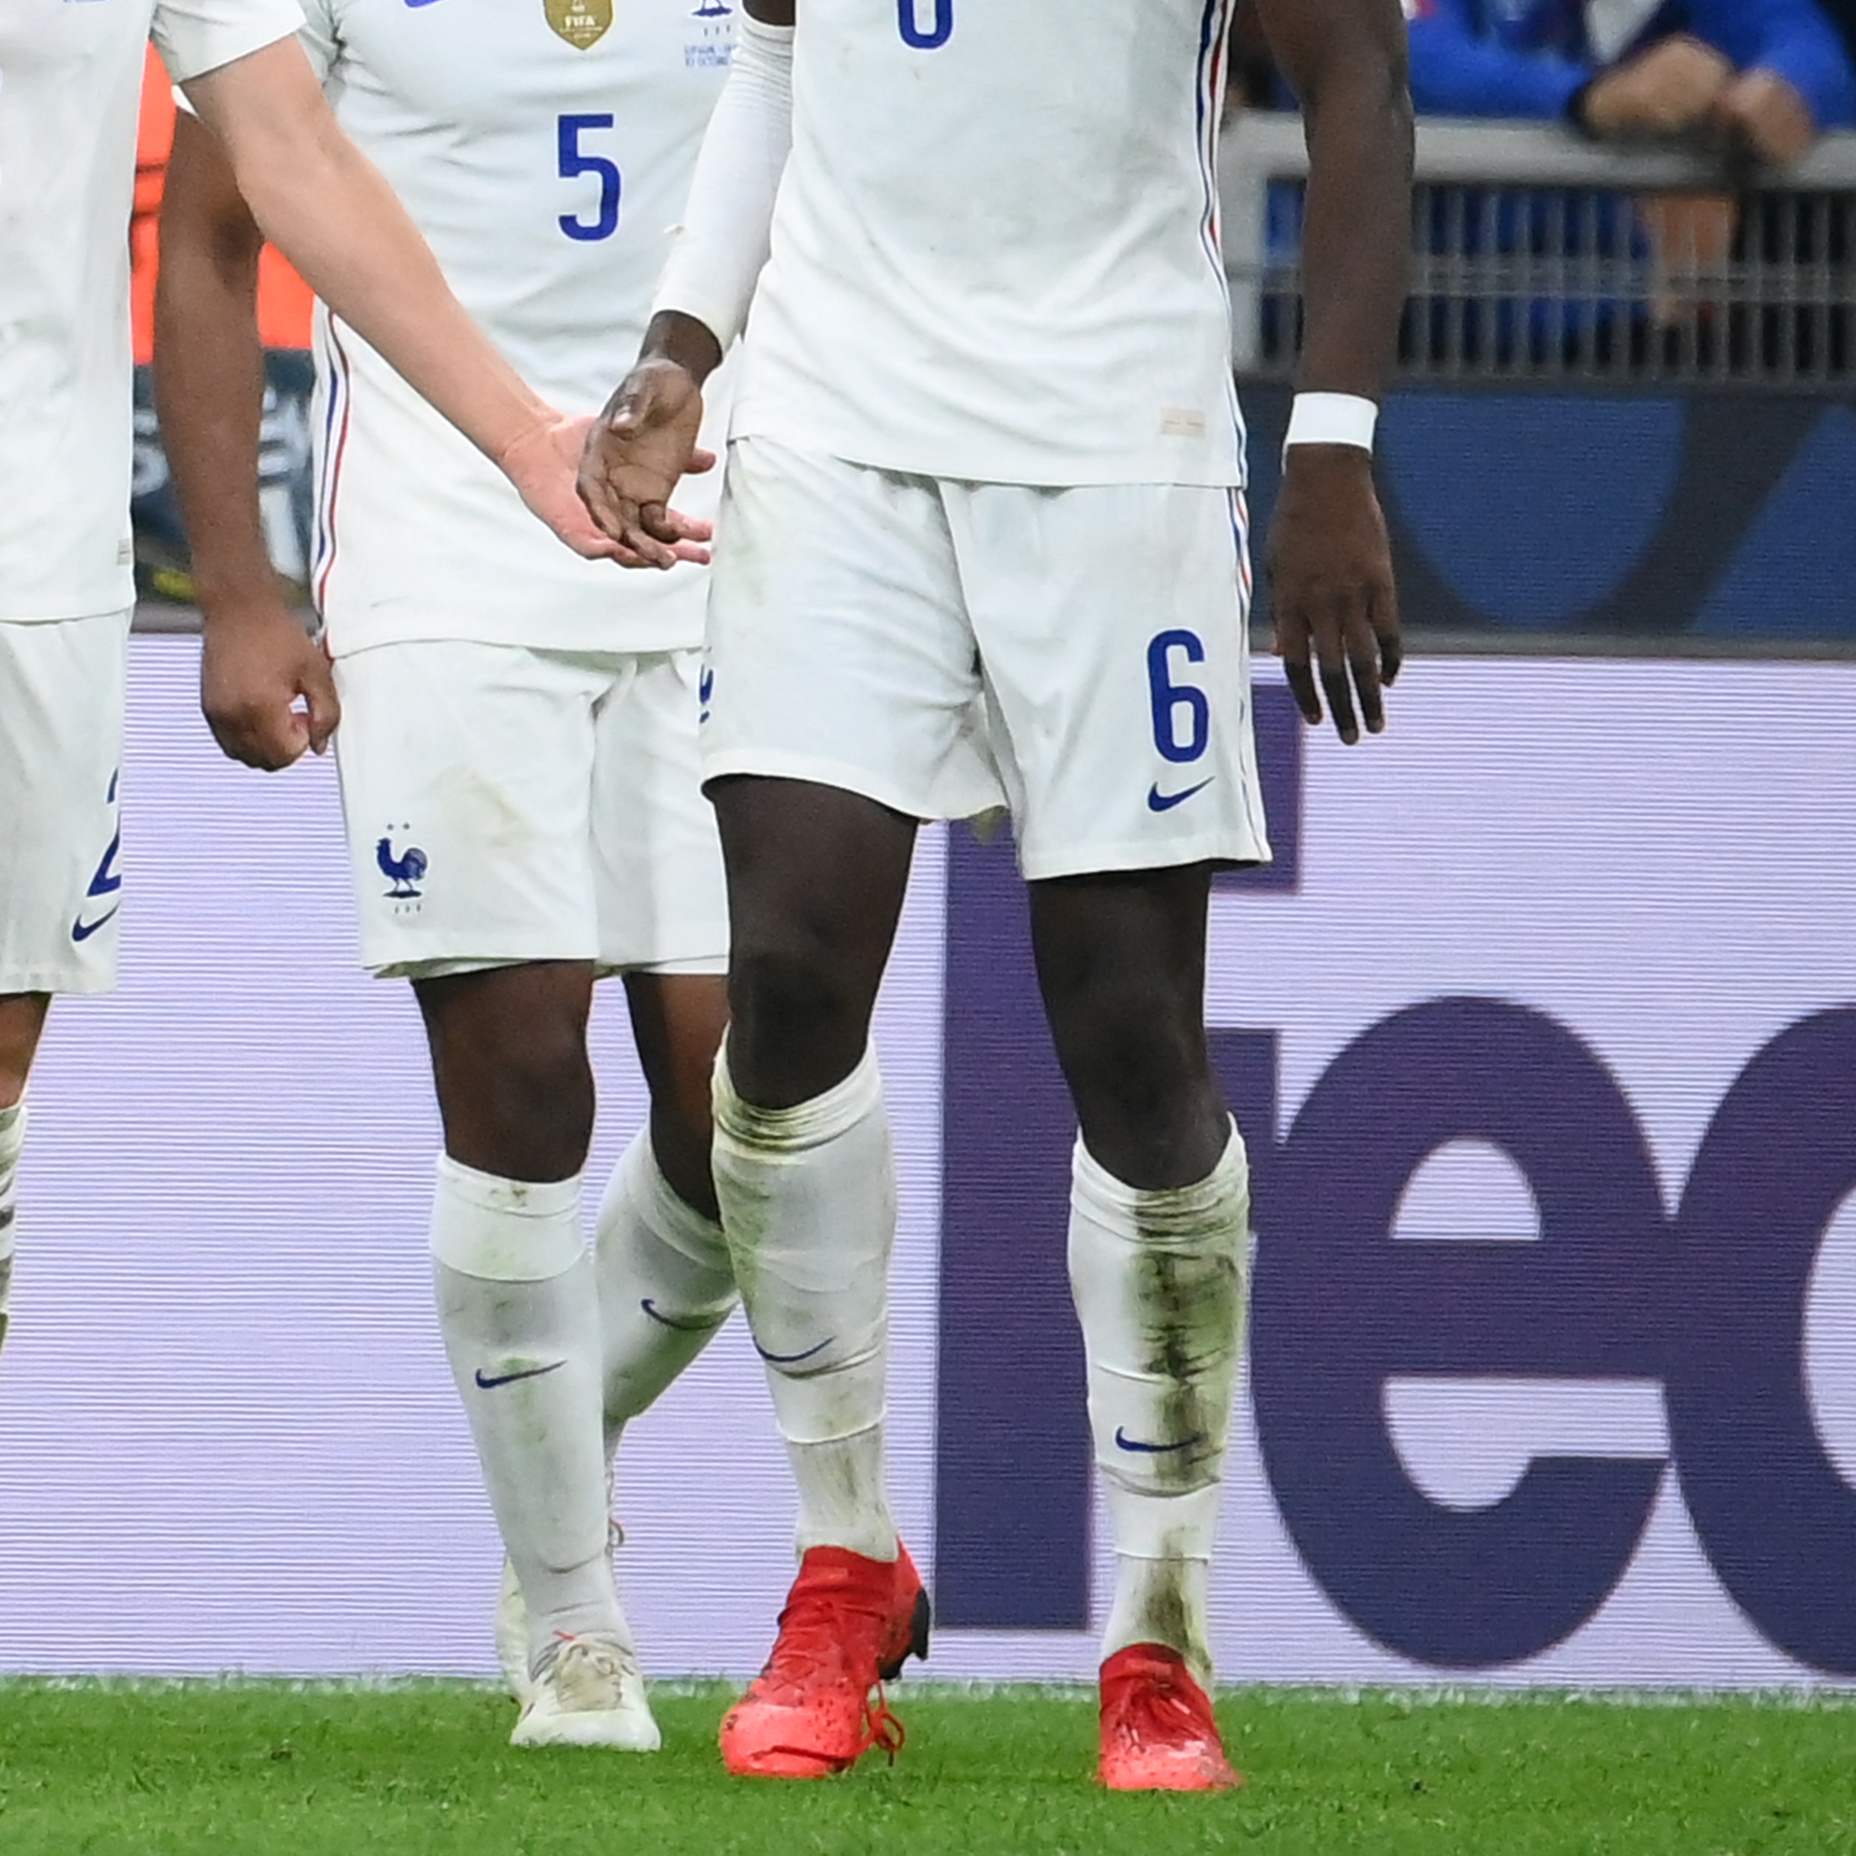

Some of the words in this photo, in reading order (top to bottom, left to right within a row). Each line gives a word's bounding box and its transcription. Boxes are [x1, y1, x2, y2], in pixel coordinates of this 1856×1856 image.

[564, 15, 596, 28] FIFA
[558, 114, 622, 242] 5
[1146, 629, 1209, 763] 6
